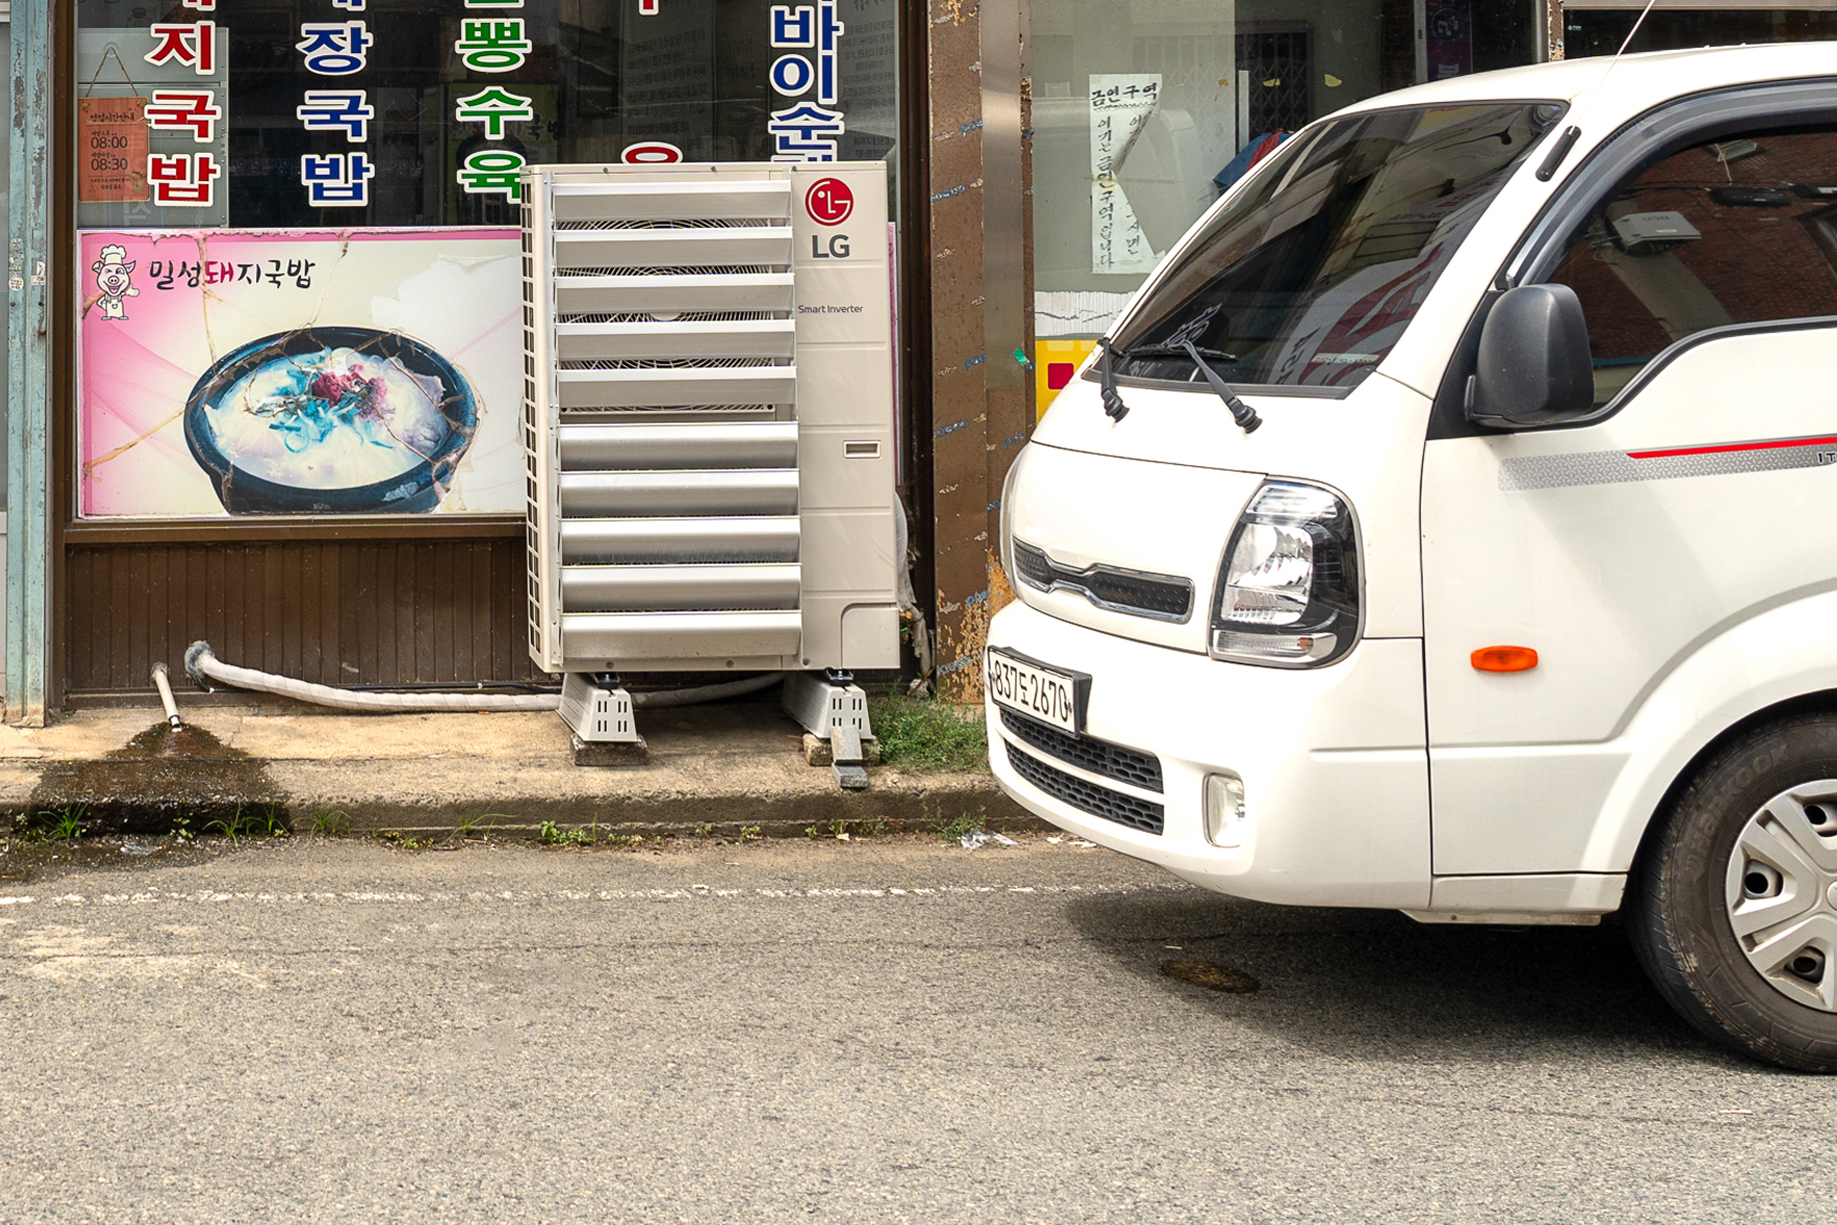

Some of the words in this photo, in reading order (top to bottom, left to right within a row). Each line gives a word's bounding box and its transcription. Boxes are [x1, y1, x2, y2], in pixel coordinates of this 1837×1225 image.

[89, 112, 135, 123] 영업시간안내
[91, 136, 128, 149] 08:00
[91, 158, 128, 171] 08:30
[811, 235, 850, 258] LG
[149, 258, 316, 291] 밀성돼지국밥
[798, 304, 824, 314] Smart
[826, 304, 863, 314] Inverter
